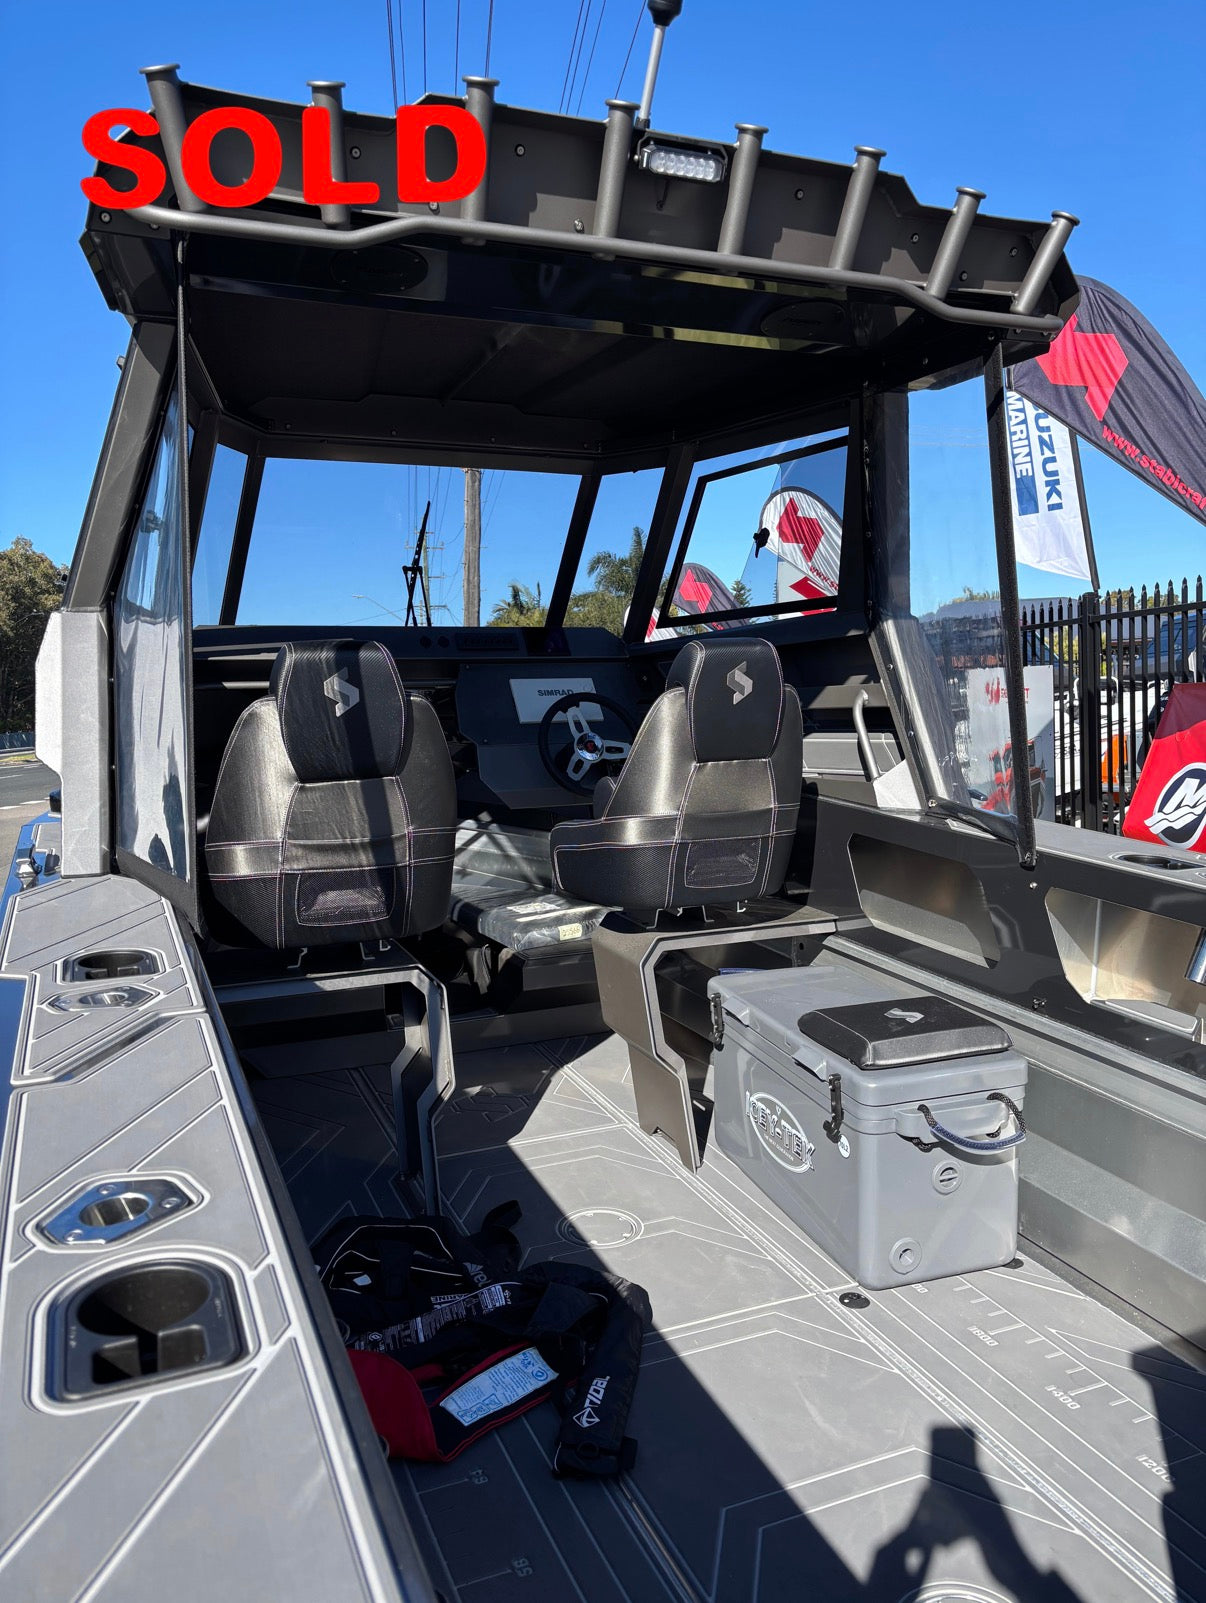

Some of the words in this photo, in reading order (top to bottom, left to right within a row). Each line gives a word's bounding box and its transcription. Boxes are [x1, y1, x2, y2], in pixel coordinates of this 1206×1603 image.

[1007, 391, 1033, 479] MARINE
[1032, 404, 1064, 512] UZUKI
[537, 689, 576, 697] SIMRAD
[746, 1090, 815, 1171] ICEY-TEK
[1044, 1384, 1082, 1411] 1400
